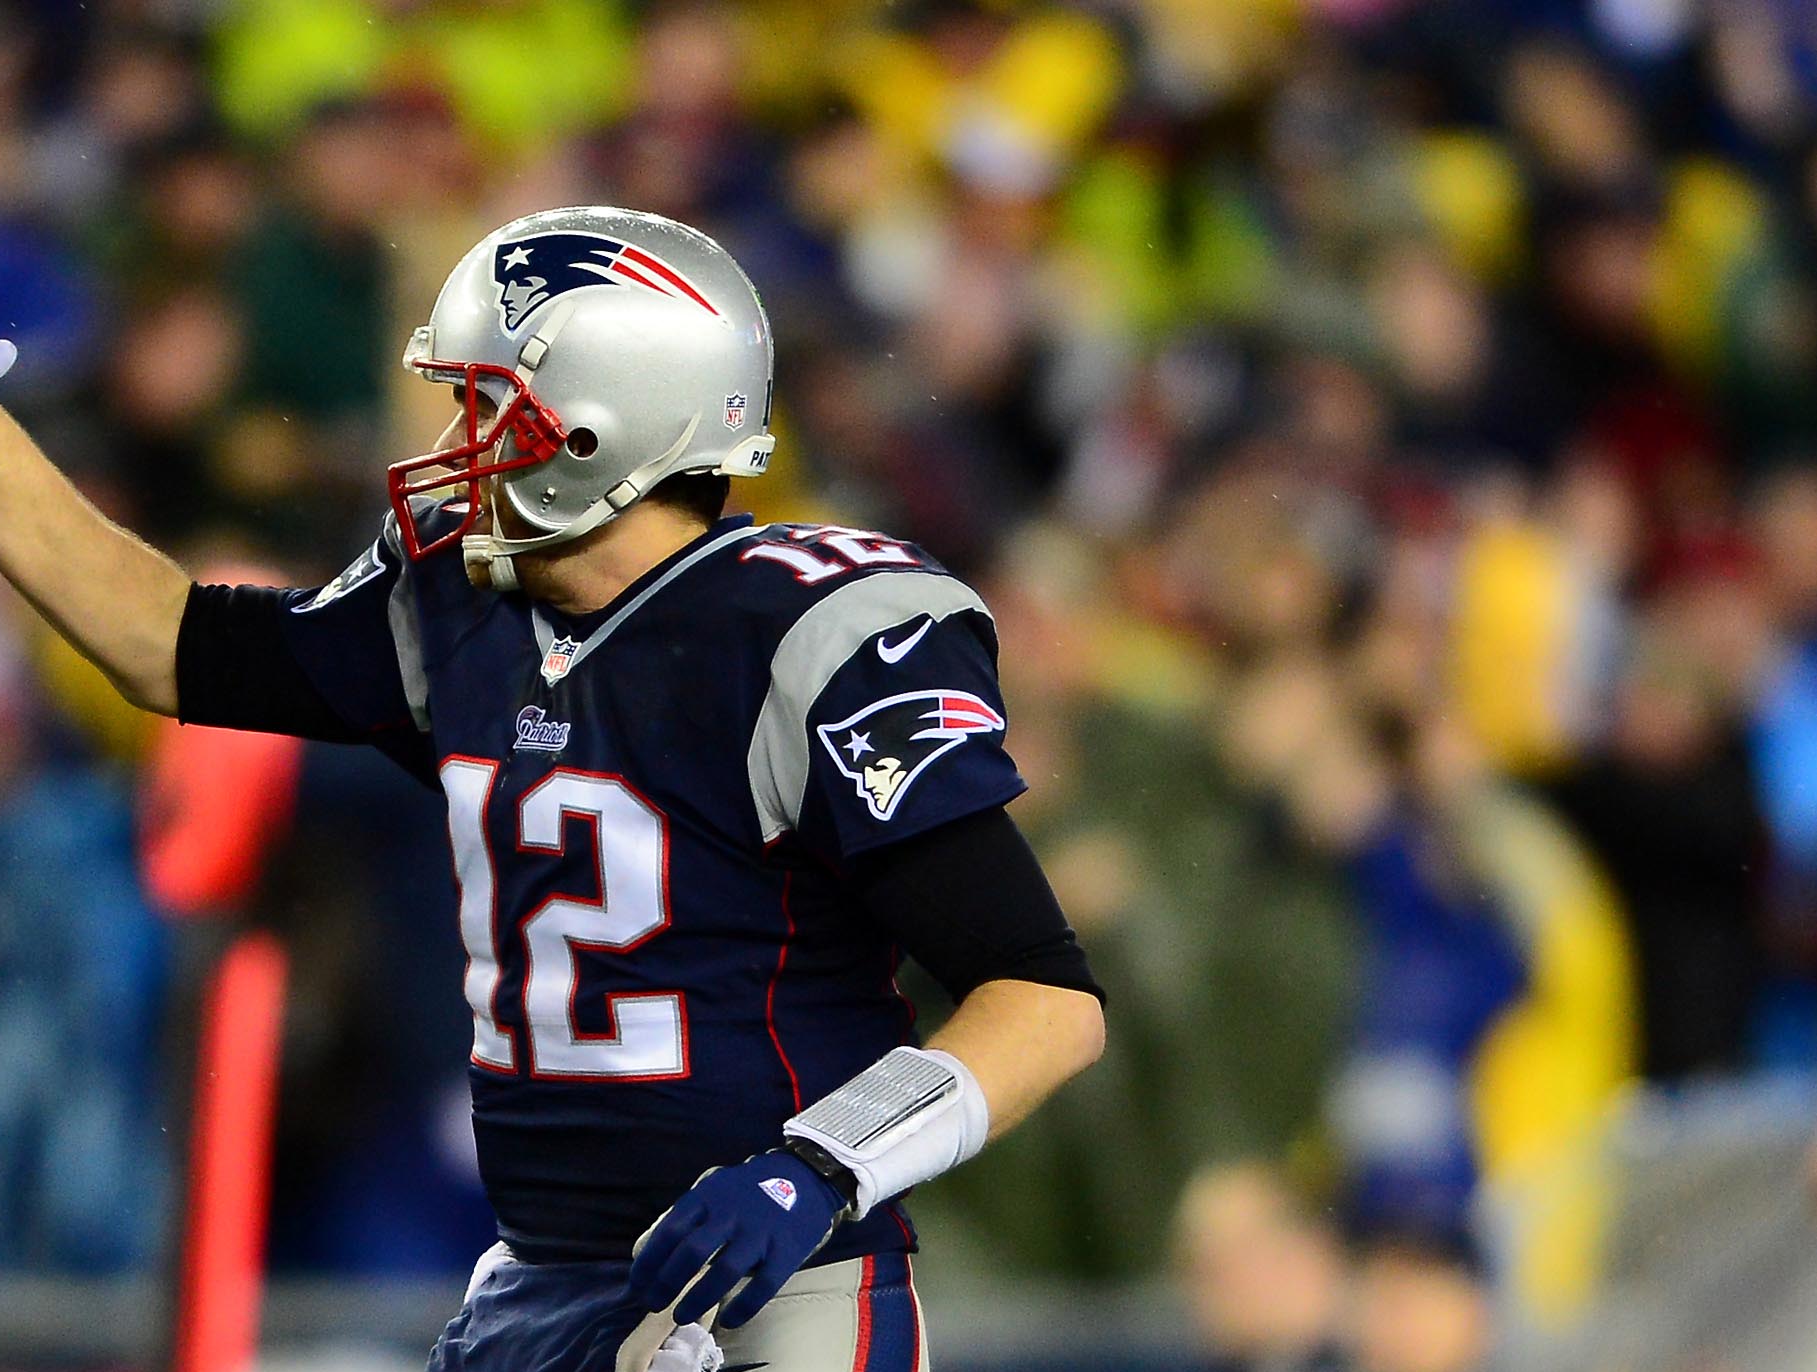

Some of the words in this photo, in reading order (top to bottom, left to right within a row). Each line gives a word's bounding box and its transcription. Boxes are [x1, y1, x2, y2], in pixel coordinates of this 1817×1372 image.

[738, 525, 922, 587] 12
[546, 655, 567, 672] NFL
[439, 753, 691, 1082] 12
